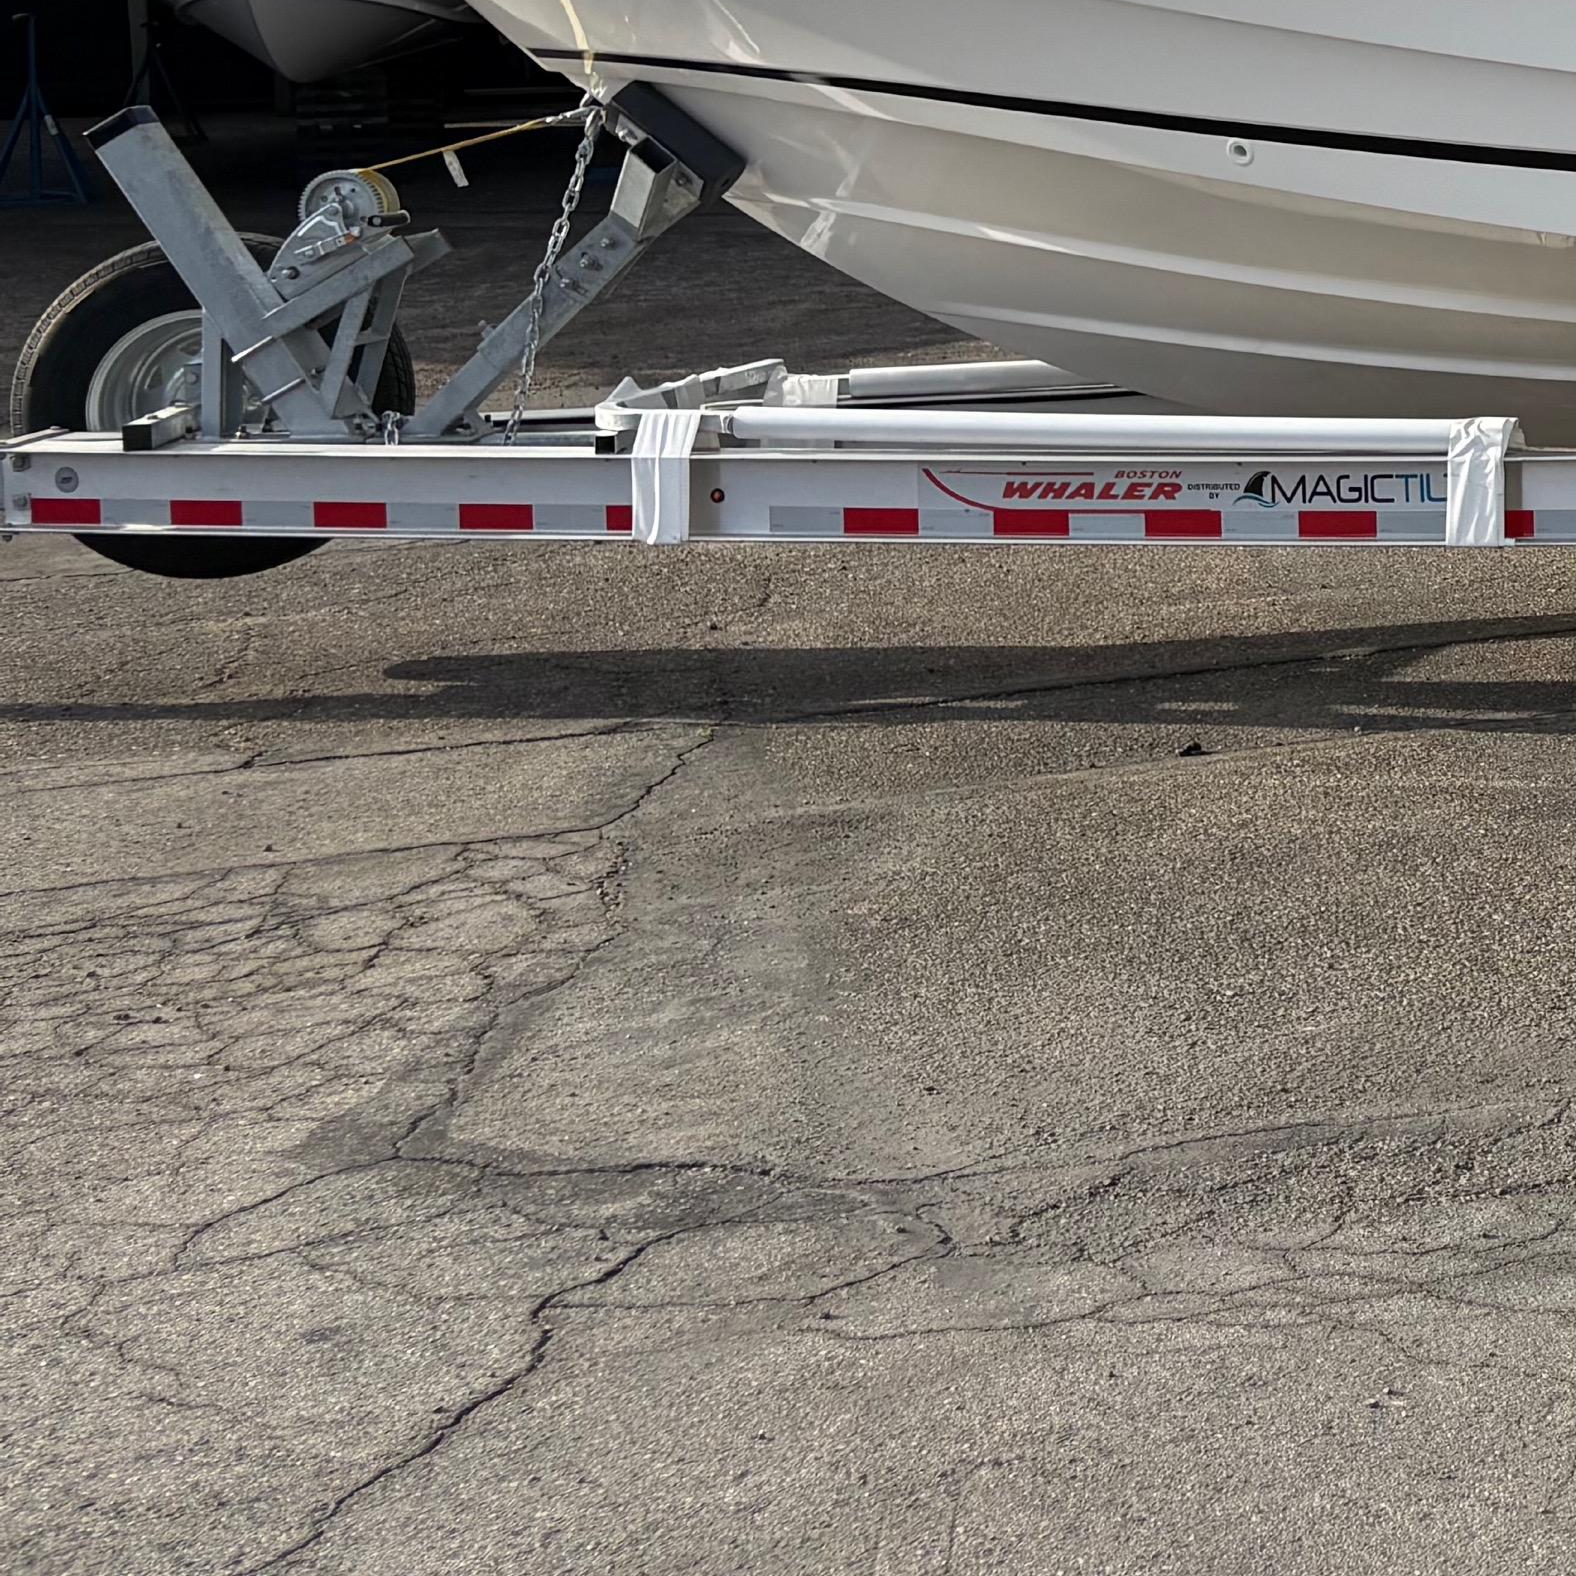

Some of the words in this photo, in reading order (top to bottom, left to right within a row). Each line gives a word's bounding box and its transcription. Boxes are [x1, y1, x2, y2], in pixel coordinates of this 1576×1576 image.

[1114, 470, 1182, 479] BOSTON
[1002, 481, 1183, 500] WHALER
[1187, 483, 1240, 491] DISTRIBUTED
[1270, 473, 1447, 503] MAGICTIL
